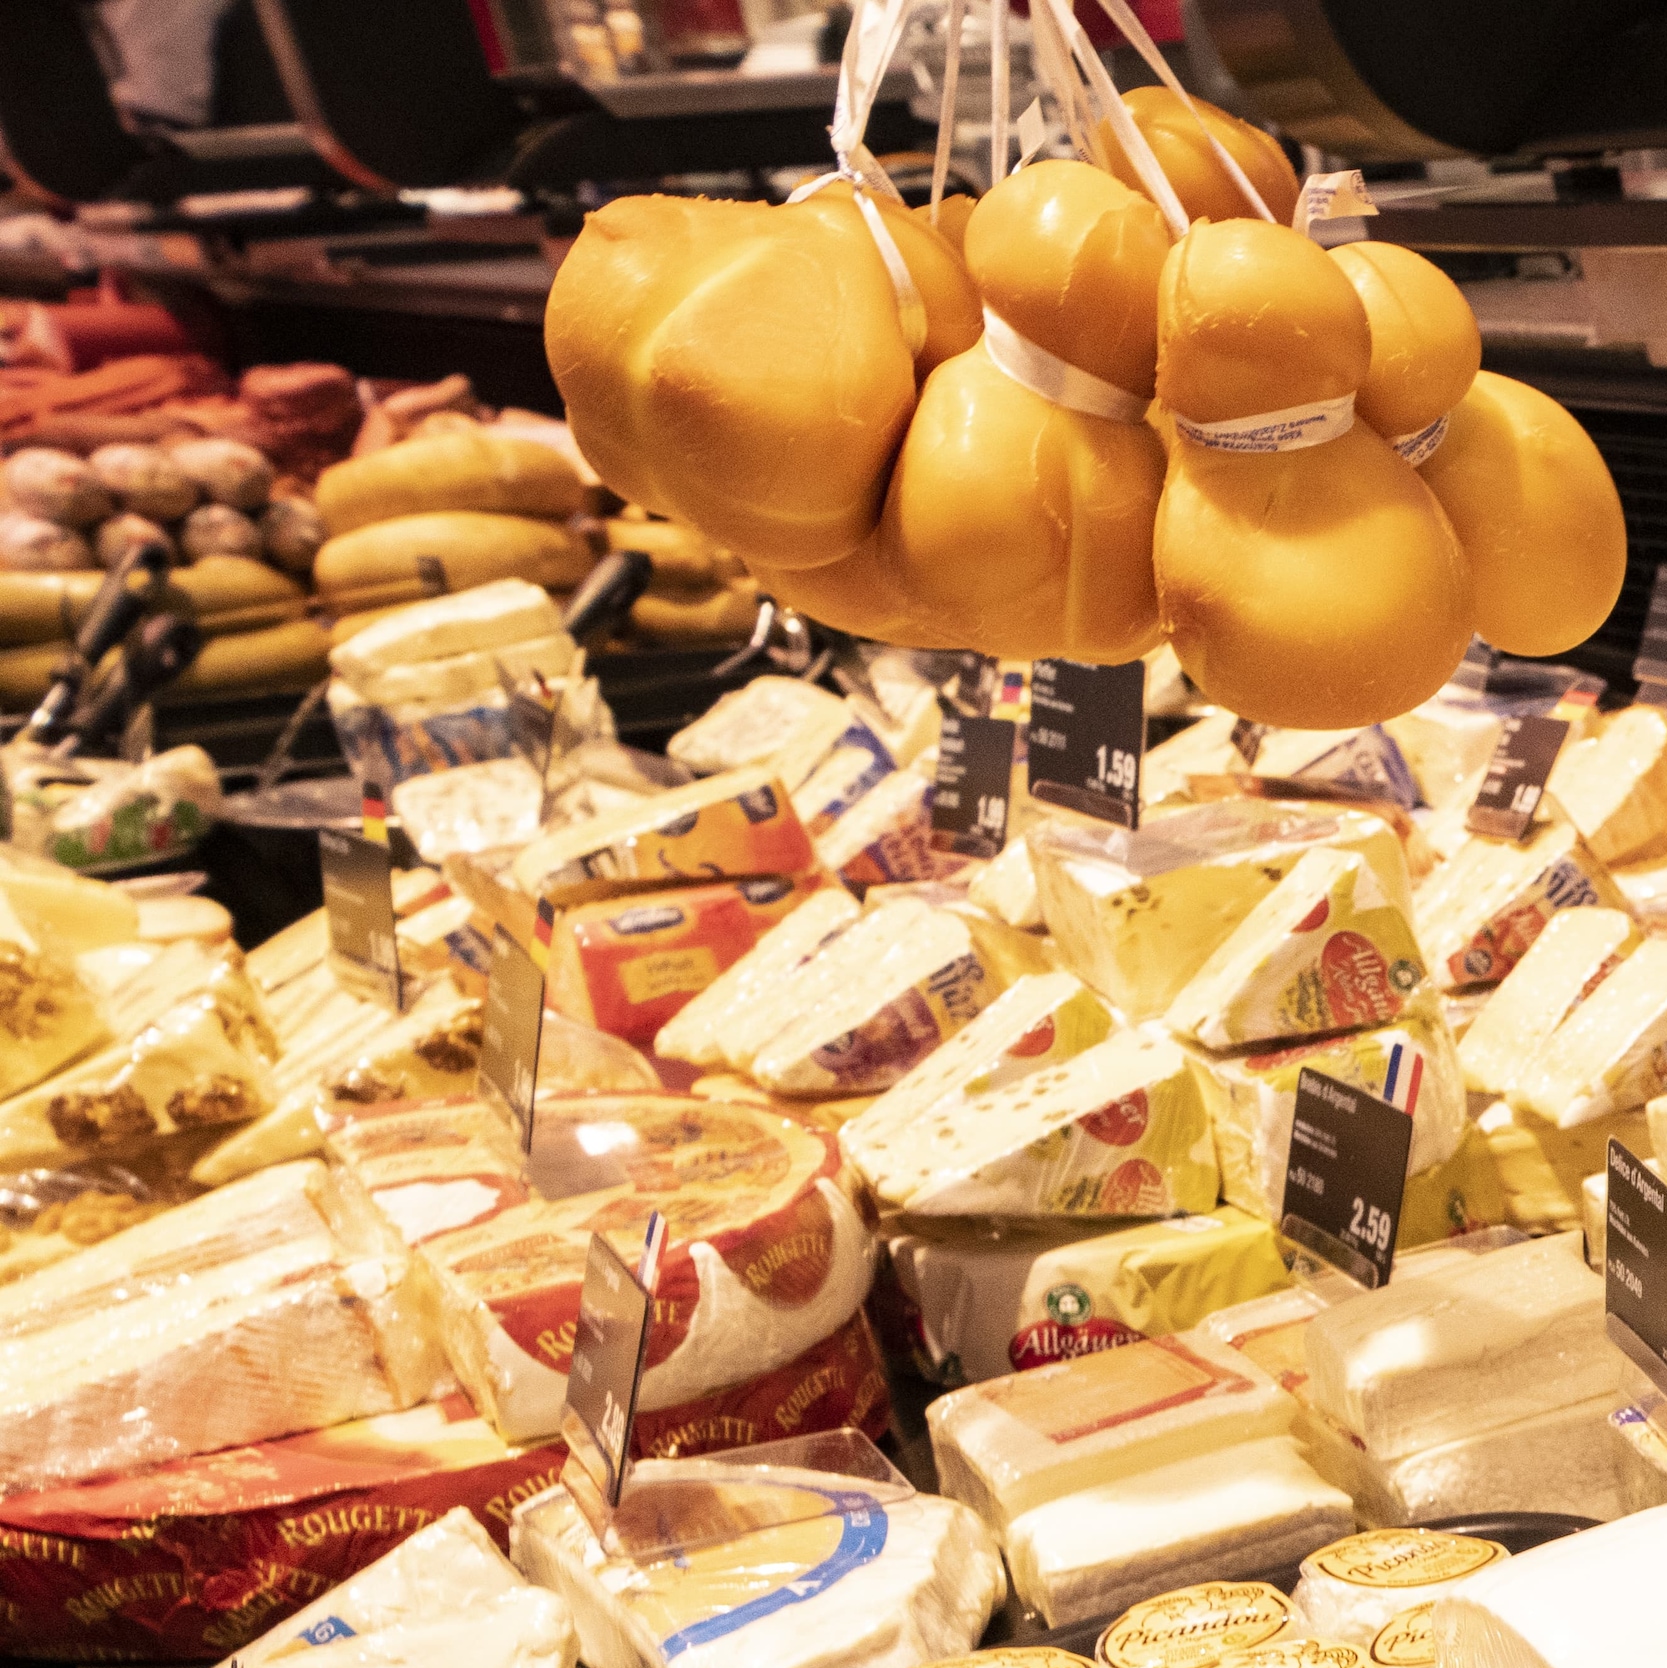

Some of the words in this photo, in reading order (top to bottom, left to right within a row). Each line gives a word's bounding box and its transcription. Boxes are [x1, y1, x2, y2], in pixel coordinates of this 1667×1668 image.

[1097, 744, 1136, 790] 1.59
[1351, 1197, 1391, 1250] 2.59
[1115, 1611, 1272, 1651] Picandou
